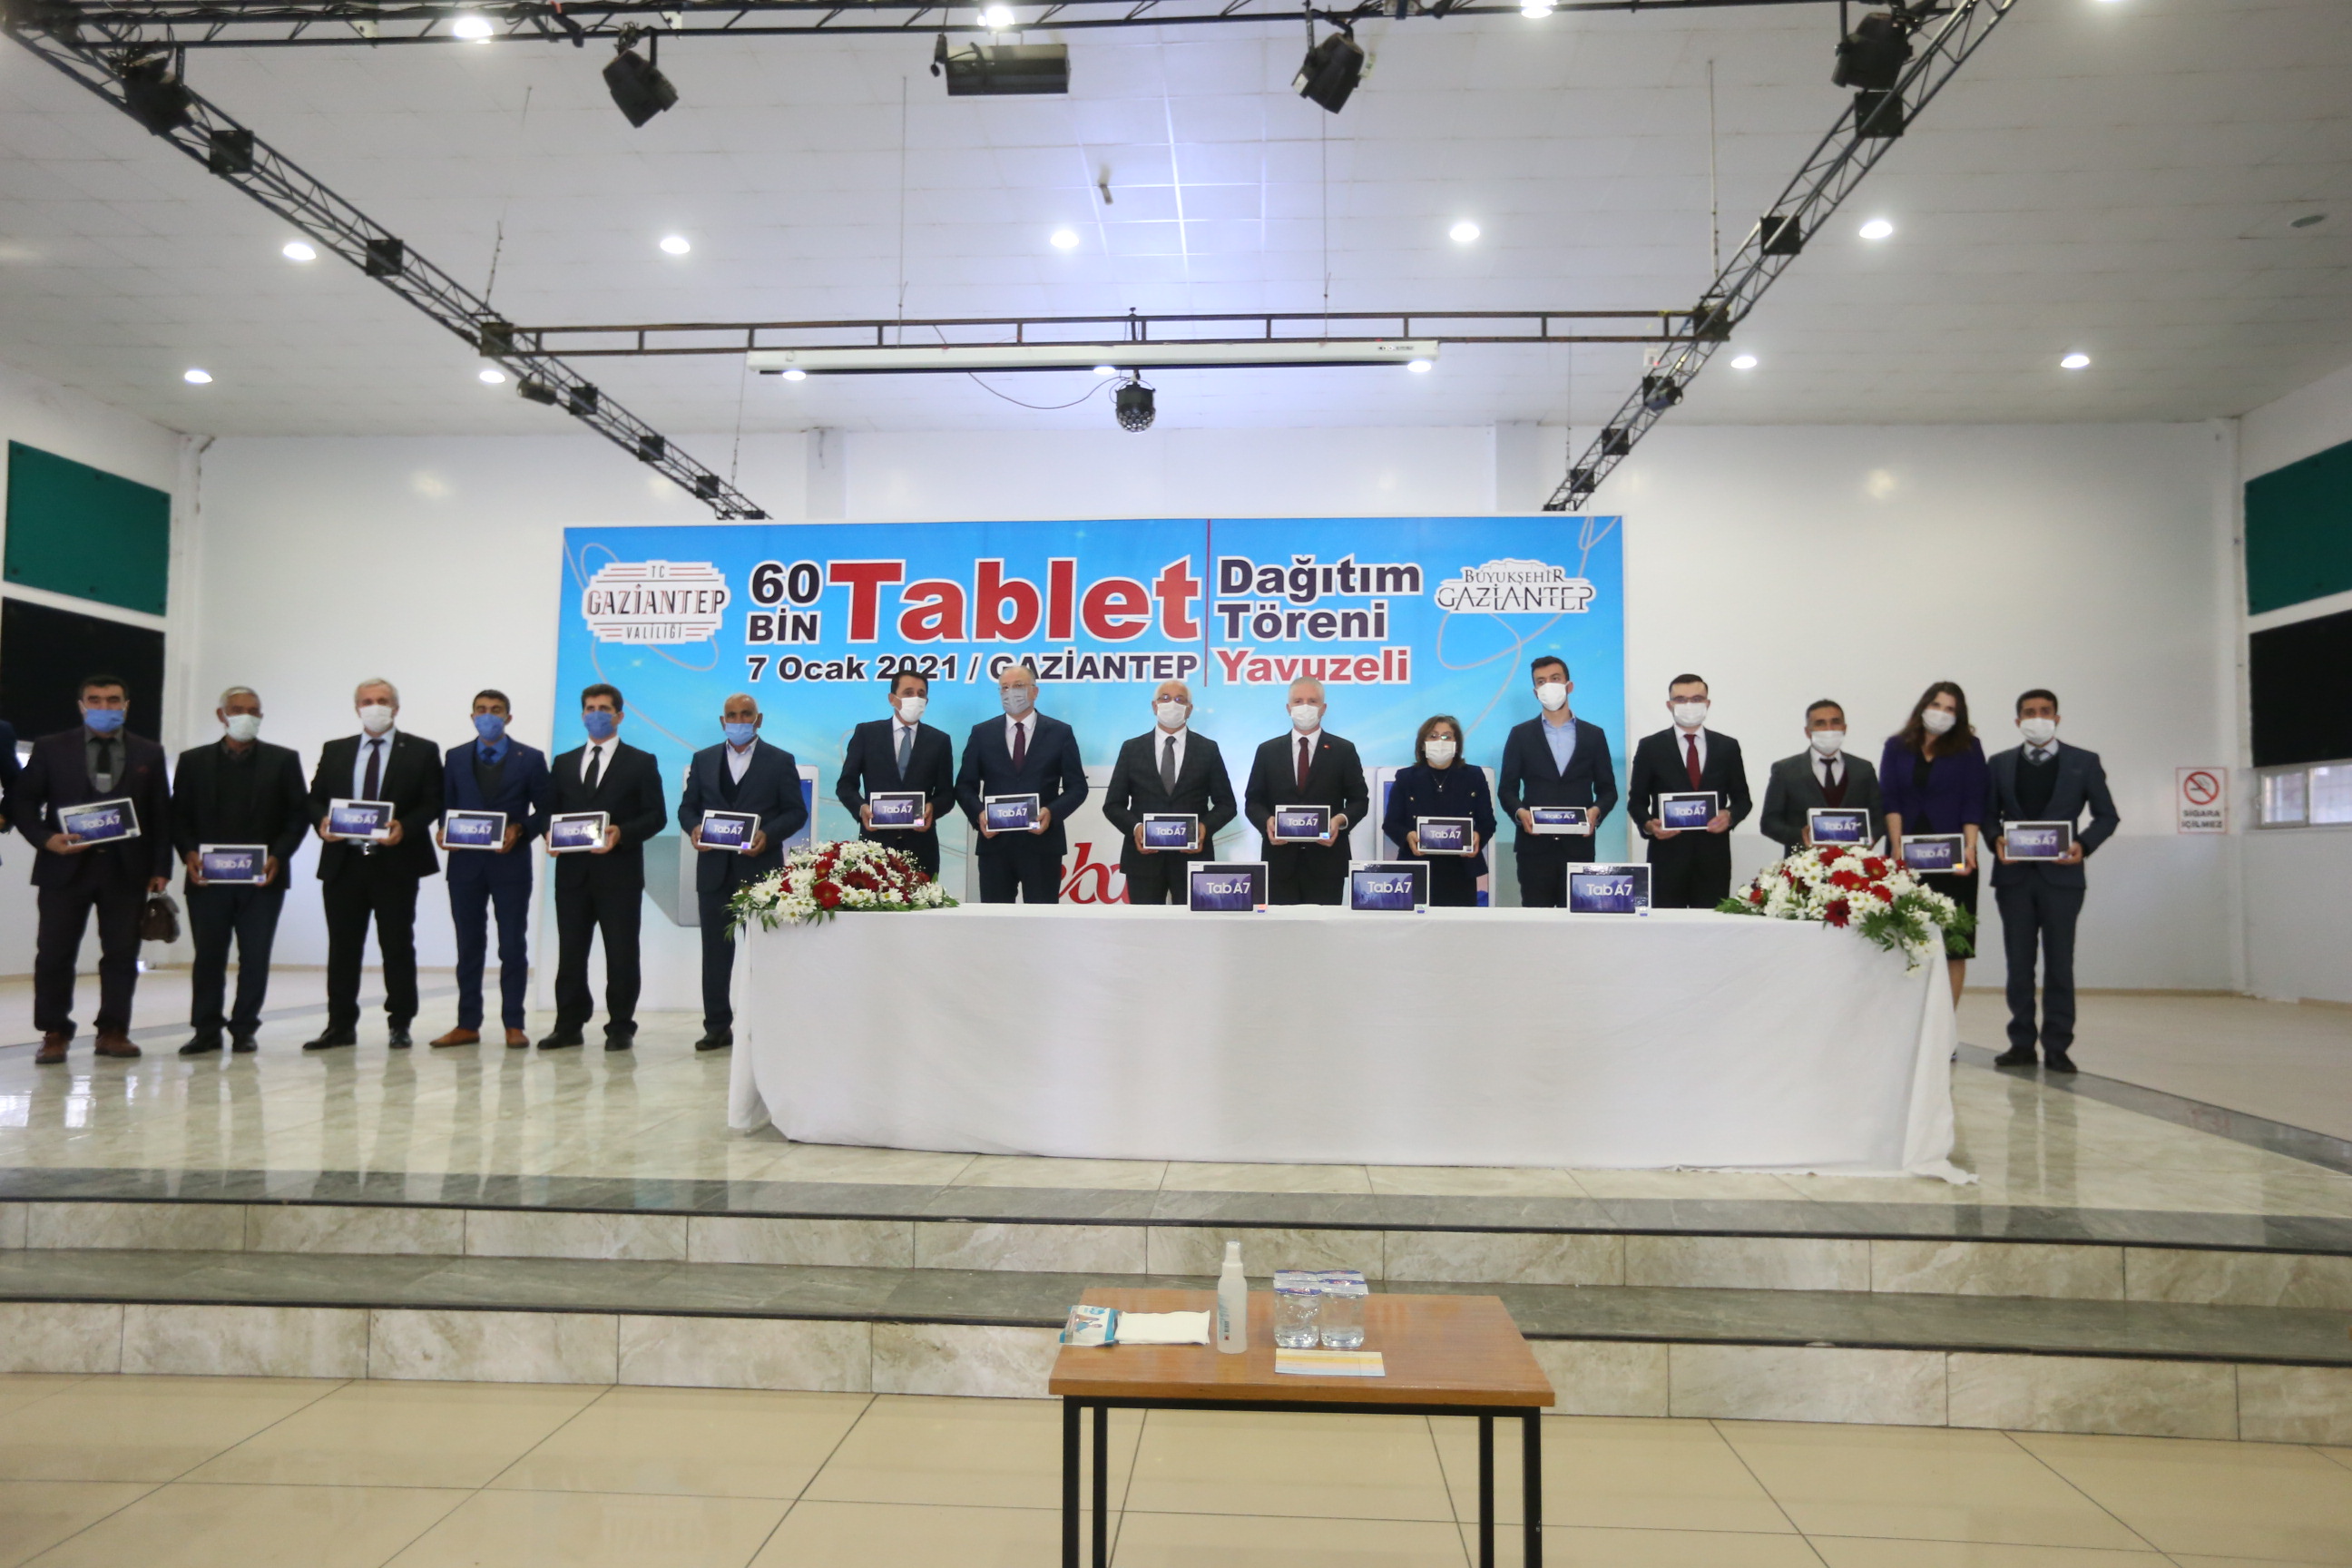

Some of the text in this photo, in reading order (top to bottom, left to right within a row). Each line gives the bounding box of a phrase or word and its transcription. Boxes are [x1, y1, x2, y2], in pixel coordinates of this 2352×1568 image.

[751, 563, 820, 604] 60
[1220, 557, 1420, 603] Dağıtım
[587, 583, 726, 615] GAZİANTEP
[829, 559, 1199, 642] Tablet
[1437, 583, 1593, 611] GAZİANTEP
[749, 607, 818, 642] BİN
[1218, 603, 1386, 639] Töreni
[749, 657, 768, 681] 7
[779, 656, 867, 680] Ocak
[877, 655, 956, 680] 2021
[968, 656, 979, 681] /
[1216, 650, 1407, 682] Yavuzeli
[882, 805, 913, 814] Tab A7
[996, 808, 1028, 818] Tab A7
[1674, 806, 1707, 817] Tab A7
[105, 815, 121, 826] A7
[363, 814, 379, 825] A7
[1288, 818, 1318, 827] Tab A7
[477, 825, 493, 835] A7
[730, 826, 744, 835] A7
[1155, 827, 1187, 836] Tab A7
[1843, 821, 1857, 831] A7
[1430, 829, 1462, 839] Tab A7
[2042, 835, 2057, 846] A7
[1936, 848, 1951, 858] A7
[237, 858, 253, 869] A7
[1206, 882, 1251, 894] Tab A7
[1367, 881, 1413, 894] Tab A7
[1585, 884, 1633, 897] Tab A7
